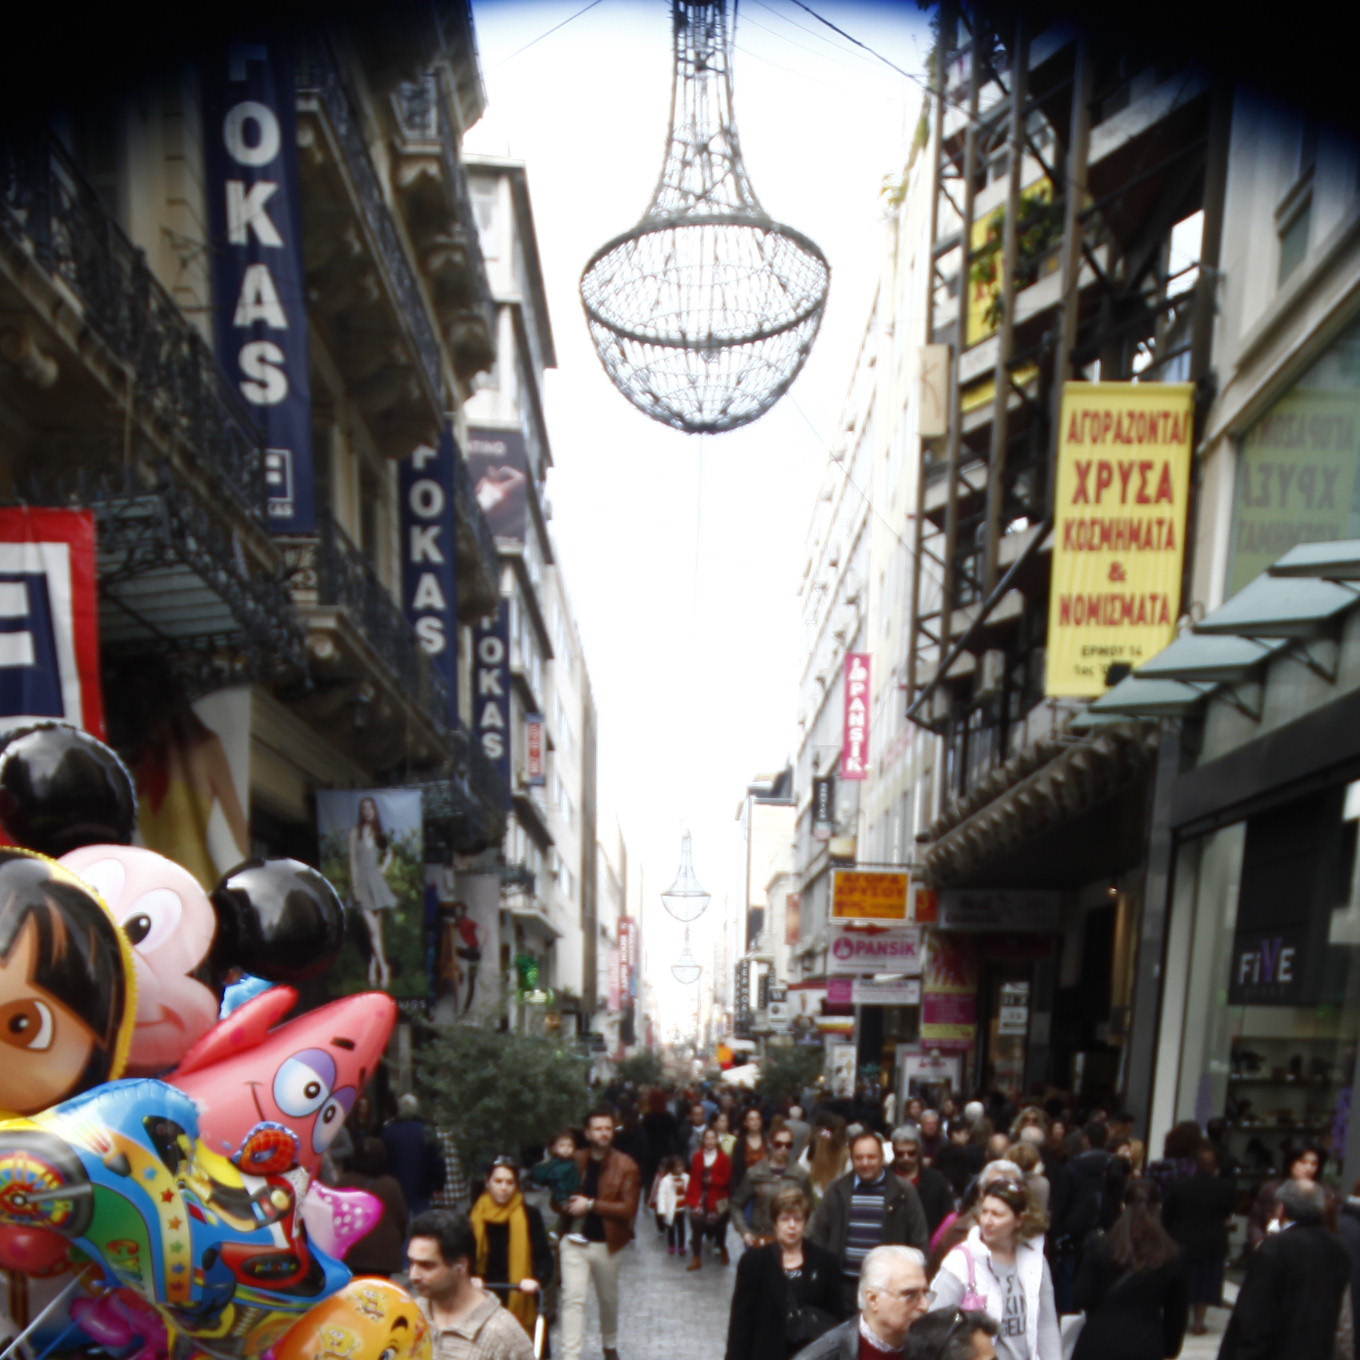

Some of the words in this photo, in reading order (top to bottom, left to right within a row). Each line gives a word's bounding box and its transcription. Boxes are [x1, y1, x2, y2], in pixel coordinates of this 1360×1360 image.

[1071, 459, 1175, 505] ΧΡΥΣΑ
[1063, 518, 1177, 551] ΚΟΣΜΗΜΑΤΑ
[1108, 560, 1126, 582] &
[1059, 593, 1171, 626] ΝΟΜΙΣΜΑΤΑ
